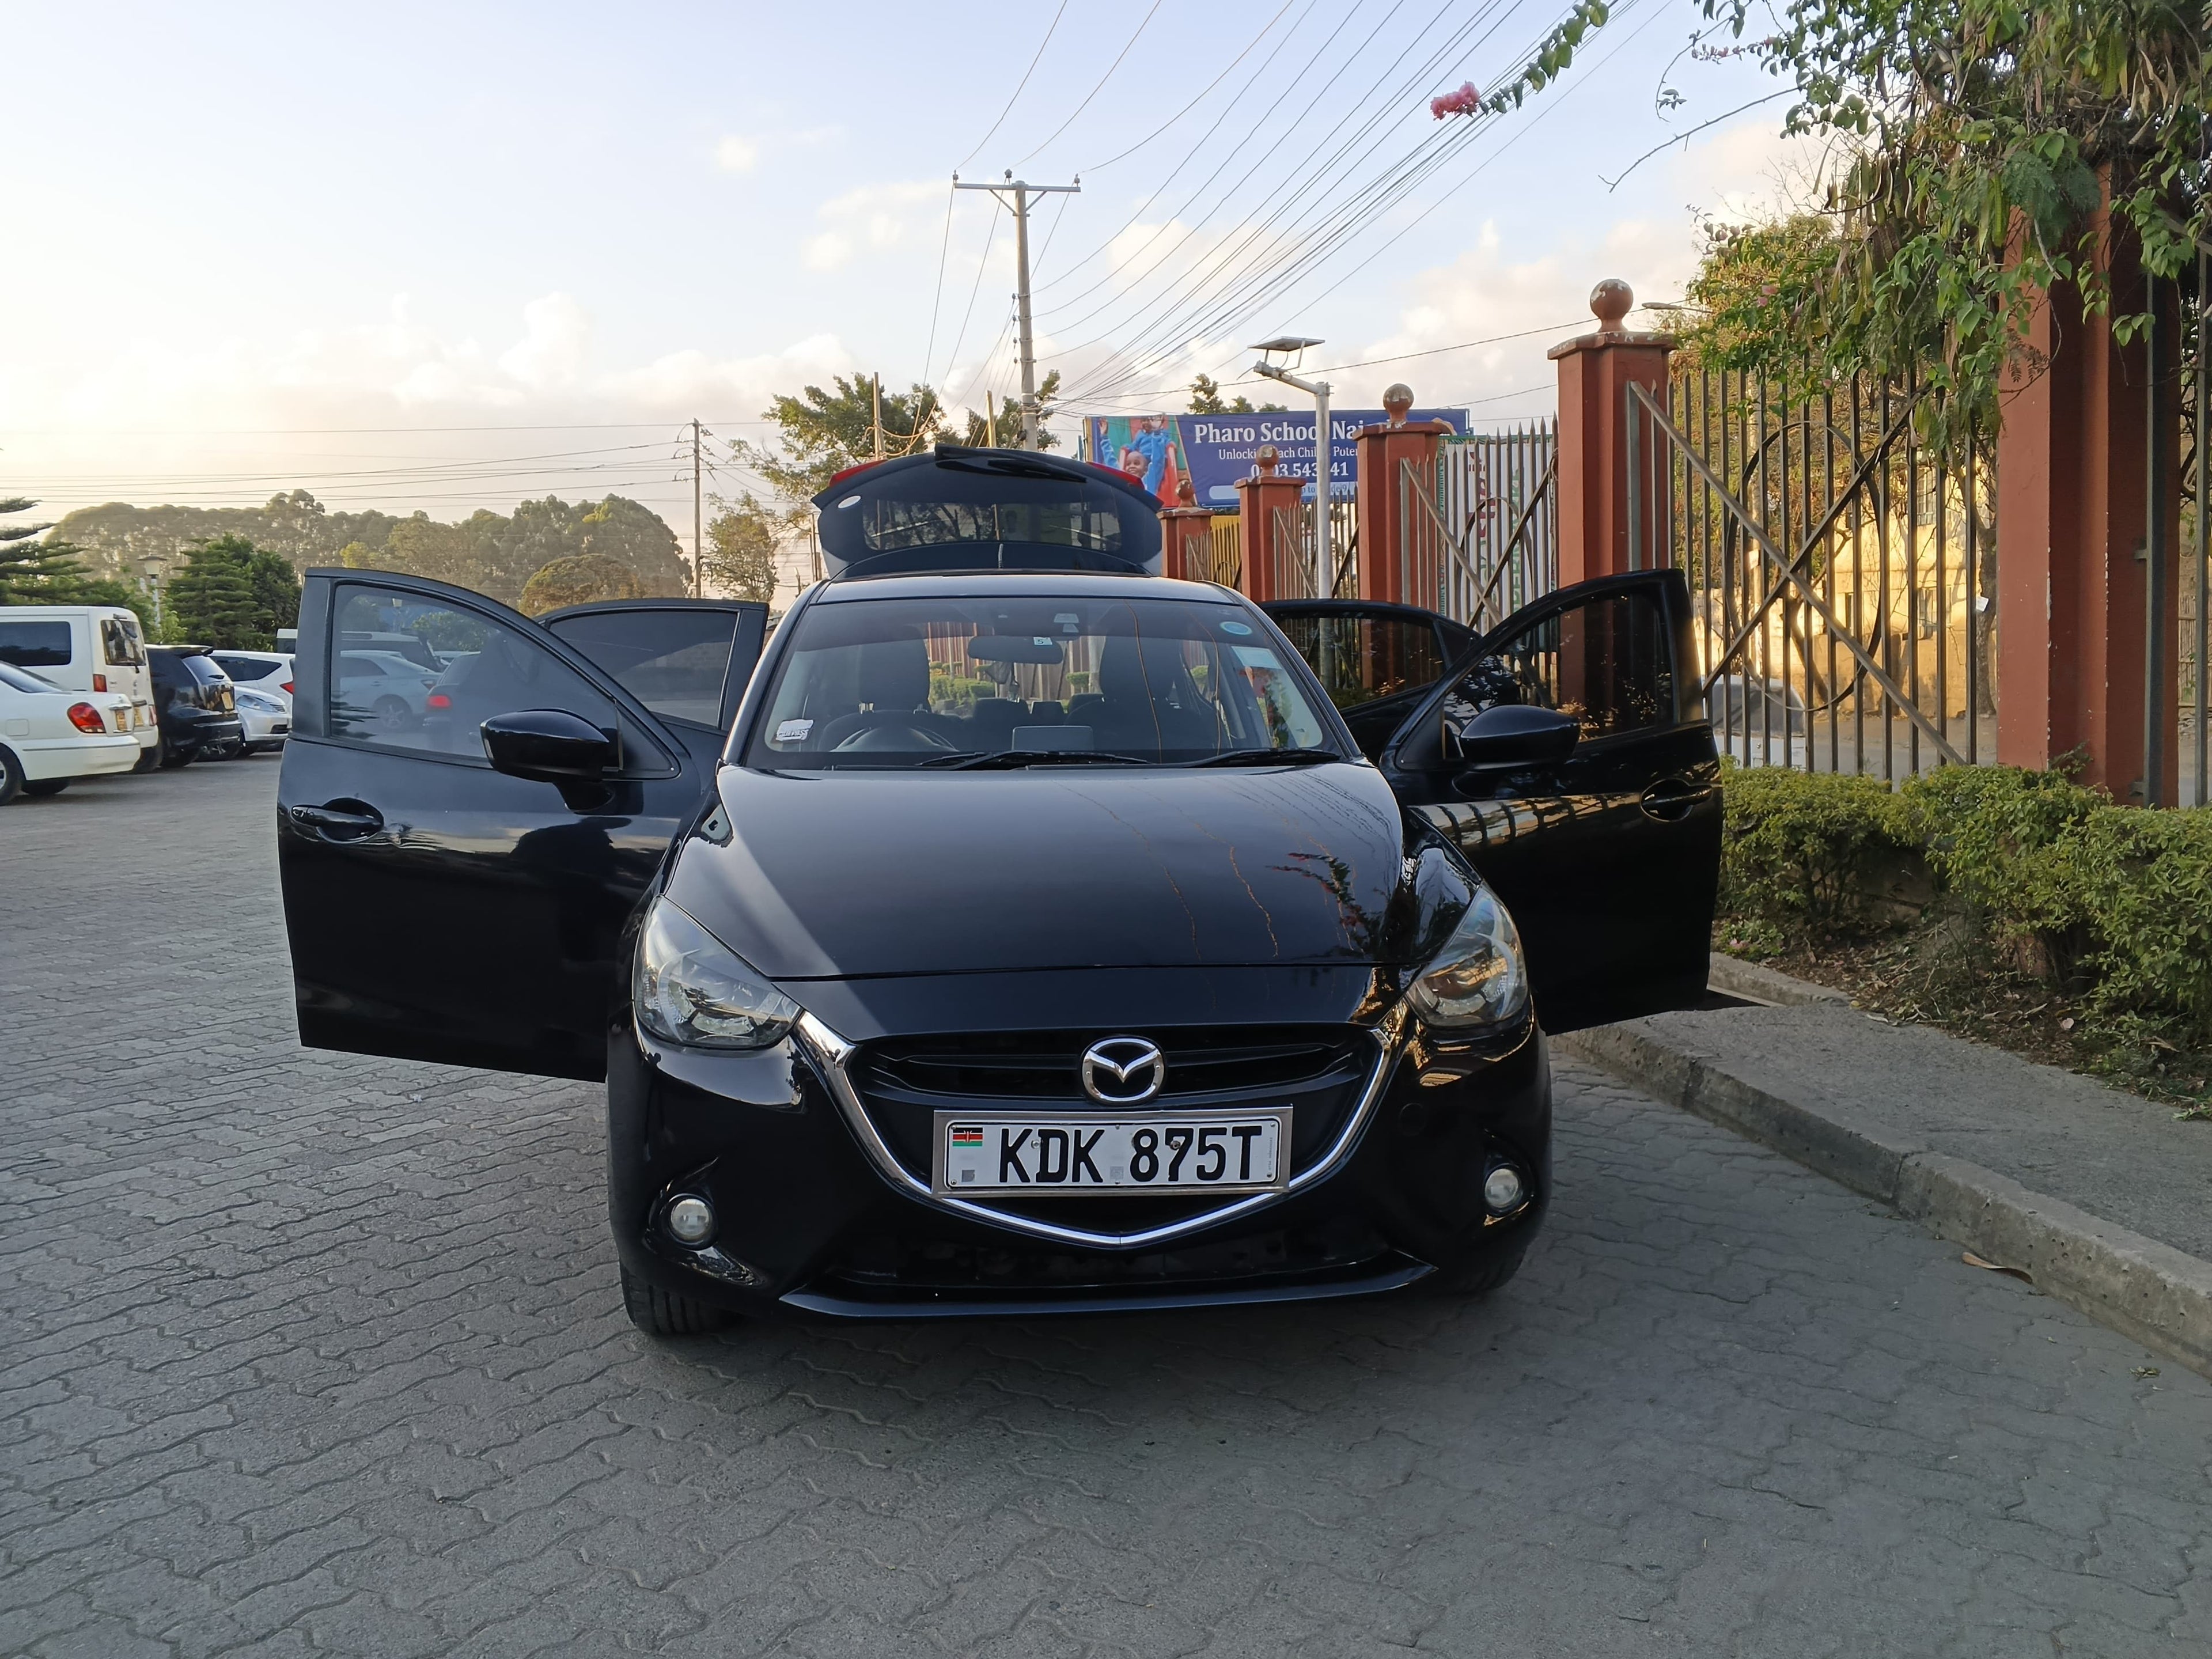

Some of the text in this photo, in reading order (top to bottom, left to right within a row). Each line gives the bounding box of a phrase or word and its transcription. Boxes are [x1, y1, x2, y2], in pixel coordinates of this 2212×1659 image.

[1195, 423, 1255, 444] Pharo
[1260, 422, 1317, 442] Schoo
[1219, 449, 1256, 460] Unlocki
[1279, 447, 1295, 458] ach
[1298, 446, 1317, 457] Chil
[999, 1128, 1105, 1183] KDK
[1130, 1125, 1263, 1182] 875T
